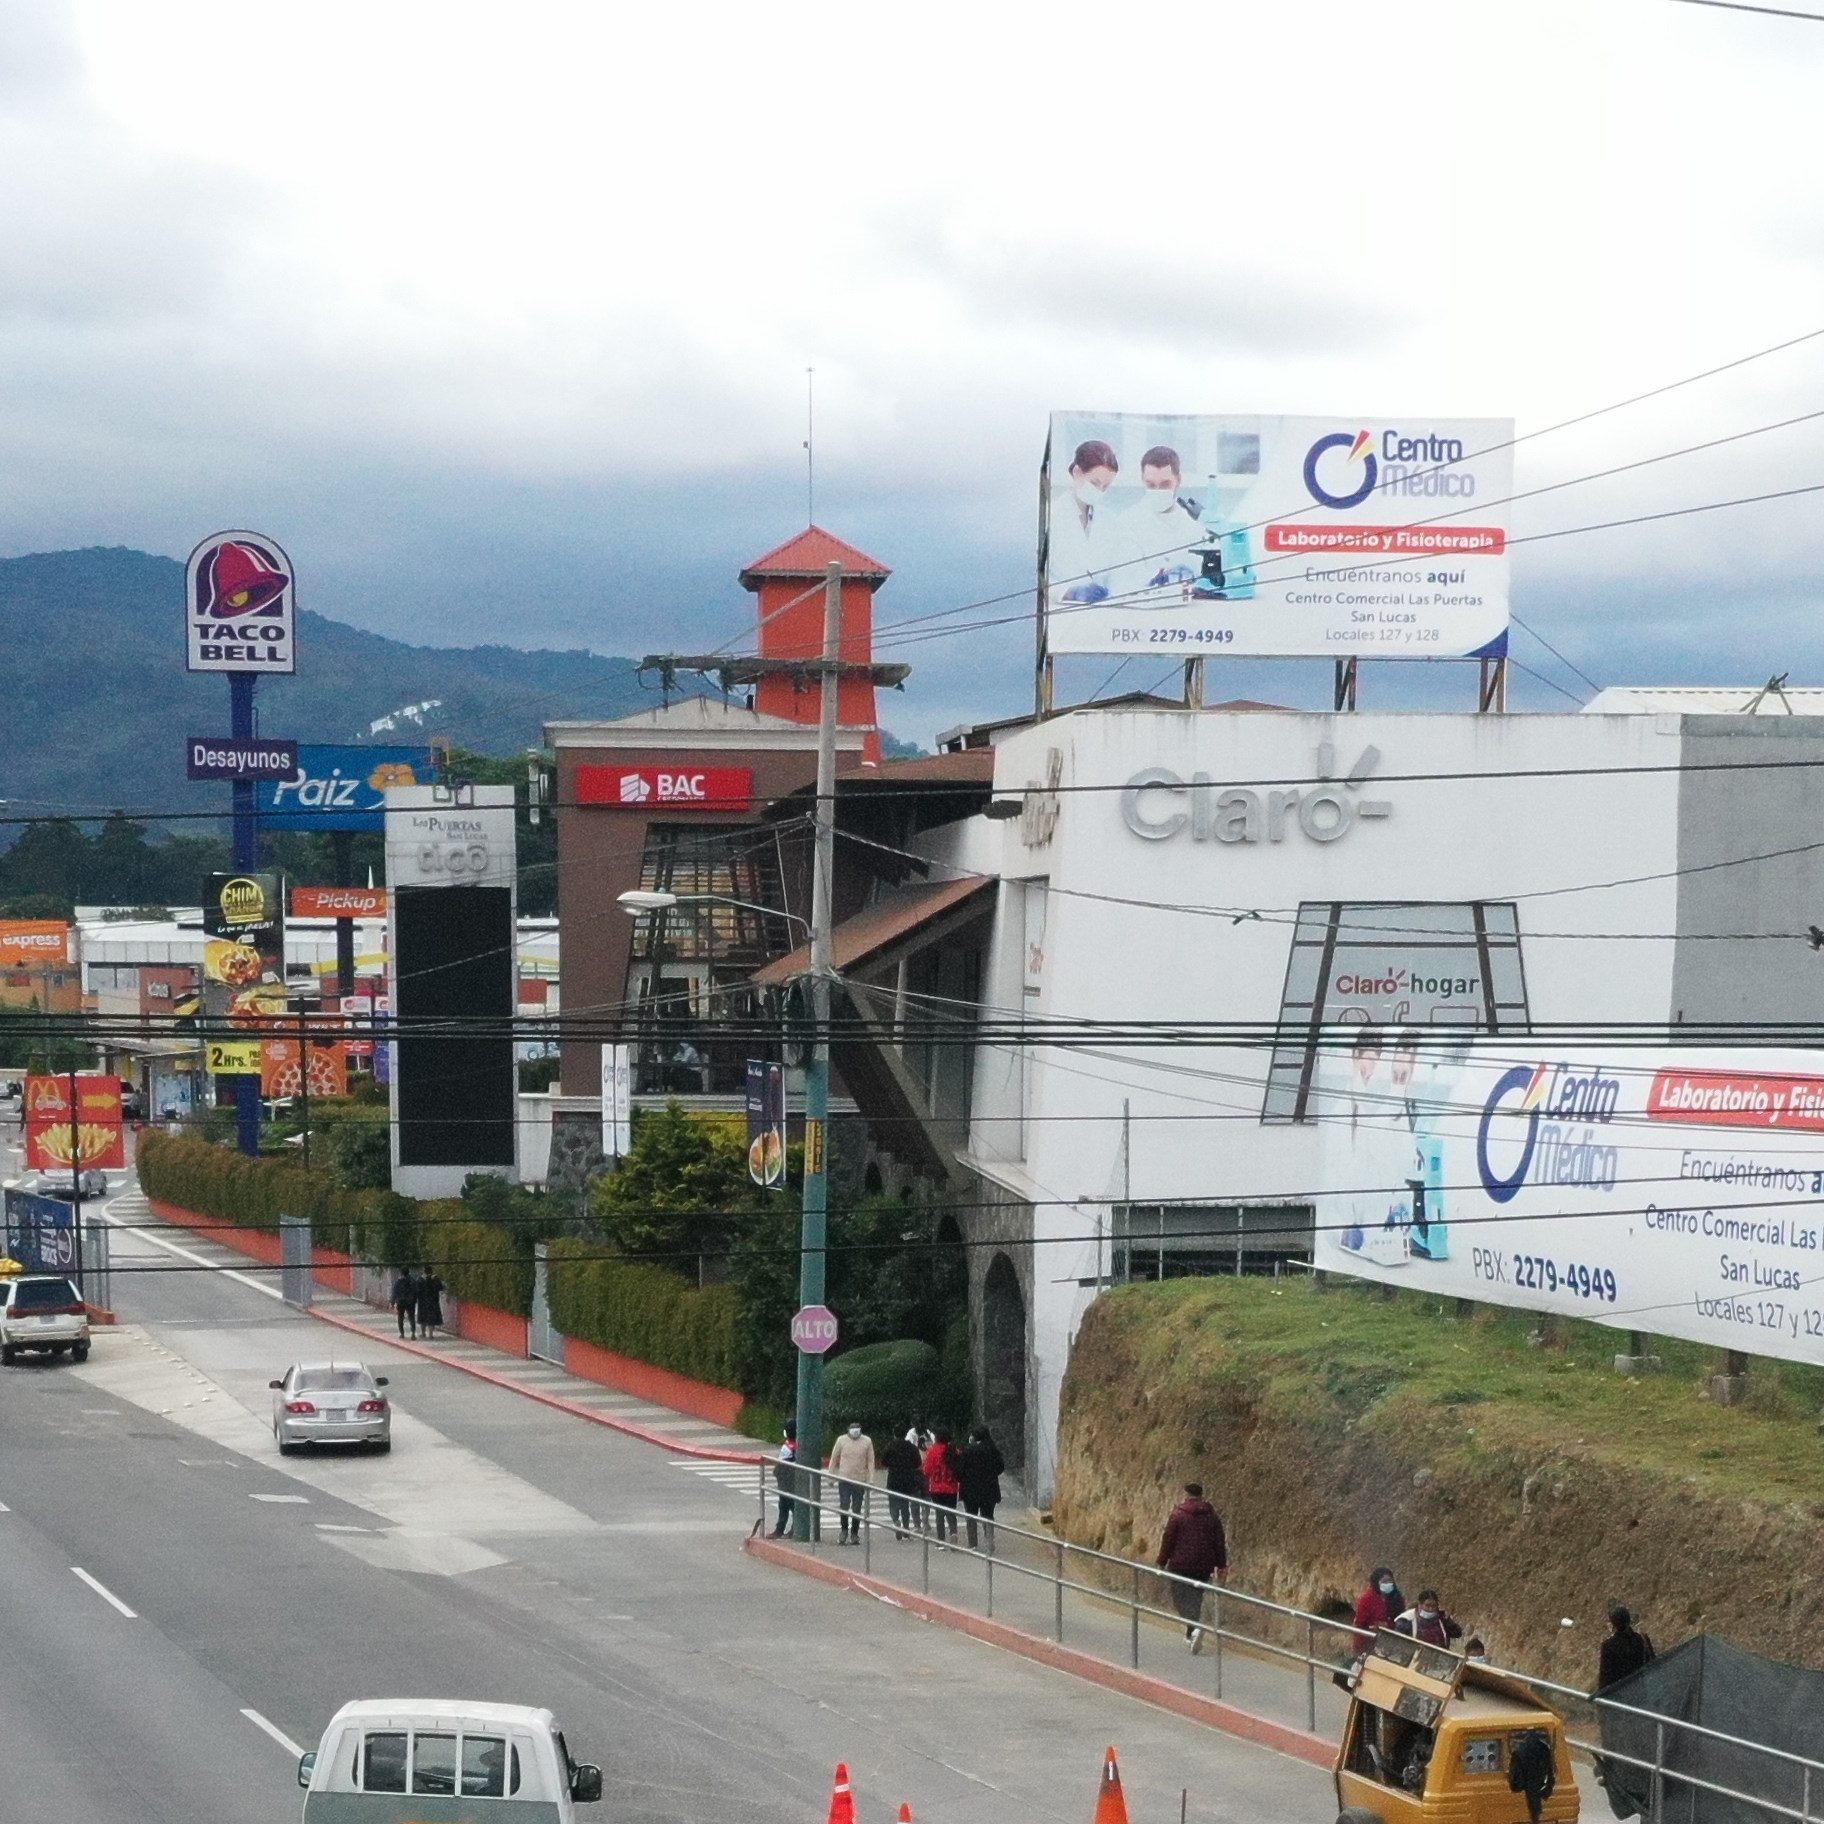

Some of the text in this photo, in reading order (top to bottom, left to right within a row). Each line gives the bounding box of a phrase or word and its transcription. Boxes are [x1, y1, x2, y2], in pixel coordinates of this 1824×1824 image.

[1382, 430, 1463, 463] Centro
[1382, 465, 1475, 498] Médico
[1279, 531, 1494, 550] Laboratorio y Fisioterapia
[1306, 567, 1466, 586] Encuéntranos aquí
[1285, 592, 1483, 606] Centro Comercial Las Puertas
[1351, 610, 1417, 624] San Lucas
[193, 623, 286, 642] TACO
[1149, 629, 1234, 643] 2279-4949
[1326, 628, 1440, 644] Locales 127 y 128
[200, 645, 288, 663] BELL
[193, 745, 291, 773] Desayunos
[272, 768, 362, 808] Paiz
[657, 774, 706, 796] BAC
[1120, 758, 1356, 844] Claro
[316, 893, 376, 911] Pickup
[3, 934, 61, 950] express
[1336, 972, 1480, 999] Claro hogar
[212, 1047, 223, 1067] 2
[224, 1054, 247, 1068] Hrs.
[1546, 1061, 1620, 1124] Centro
[1659, 1078, 1768, 1115] Laboratorio
[1768, 1092, 1785, 1123] y
[1535, 1124, 1619, 1192] Médico
[1680, 1151, 1806, 1191] Encuéntranos
[1645, 1204, 1698, 1235] Centro
[1702, 1210, 1785, 1246] Comercial
[1789, 1221, 1817, 1251] Las
[1472, 1247, 1618, 1303] PBX: 2279-4949
[1720, 1254, 1801, 1291] San Lucas
[1694, 1291, 1752, 1325] Locales
[1757, 1301, 1784, 1330] 127
[1788, 1312, 1799, 1339] y
[794, 1321, 837, 1339] ALTO
